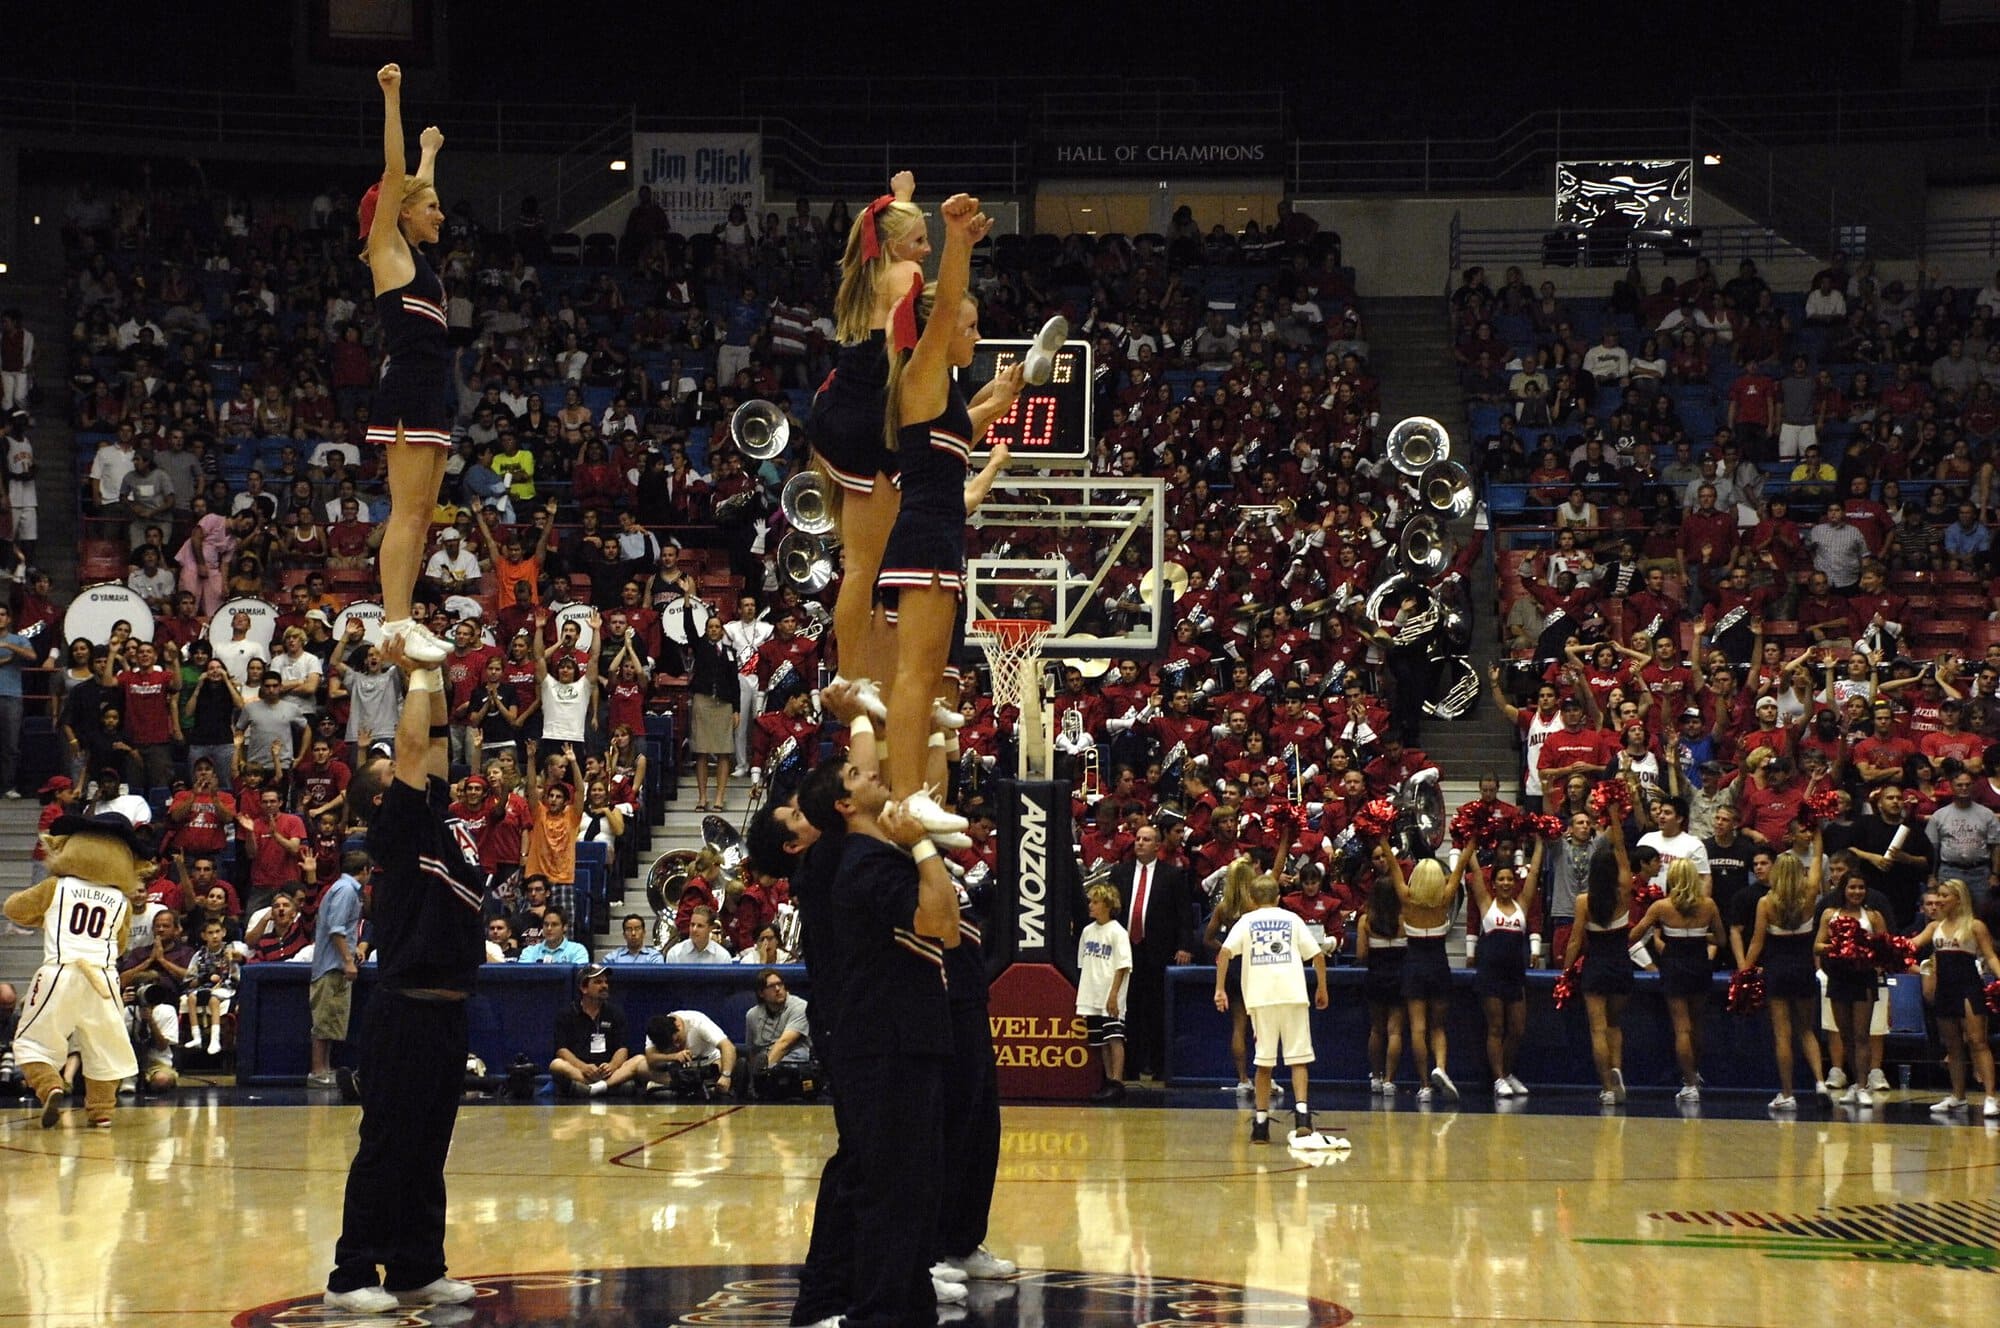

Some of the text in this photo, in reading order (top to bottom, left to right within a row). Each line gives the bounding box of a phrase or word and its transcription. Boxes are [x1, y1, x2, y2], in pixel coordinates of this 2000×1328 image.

[1057, 144, 1265, 161] HALL OF CHAMPIONS
[643, 147, 752, 184] Jim Click
[100, 593, 129, 602] YAMAHA
[1019, 792, 1047, 952] ARIZONA
[71, 888, 117, 908] WILBUR
[69, 902, 107, 939] 00
[992, 1044, 1089, 1068] ARGO
